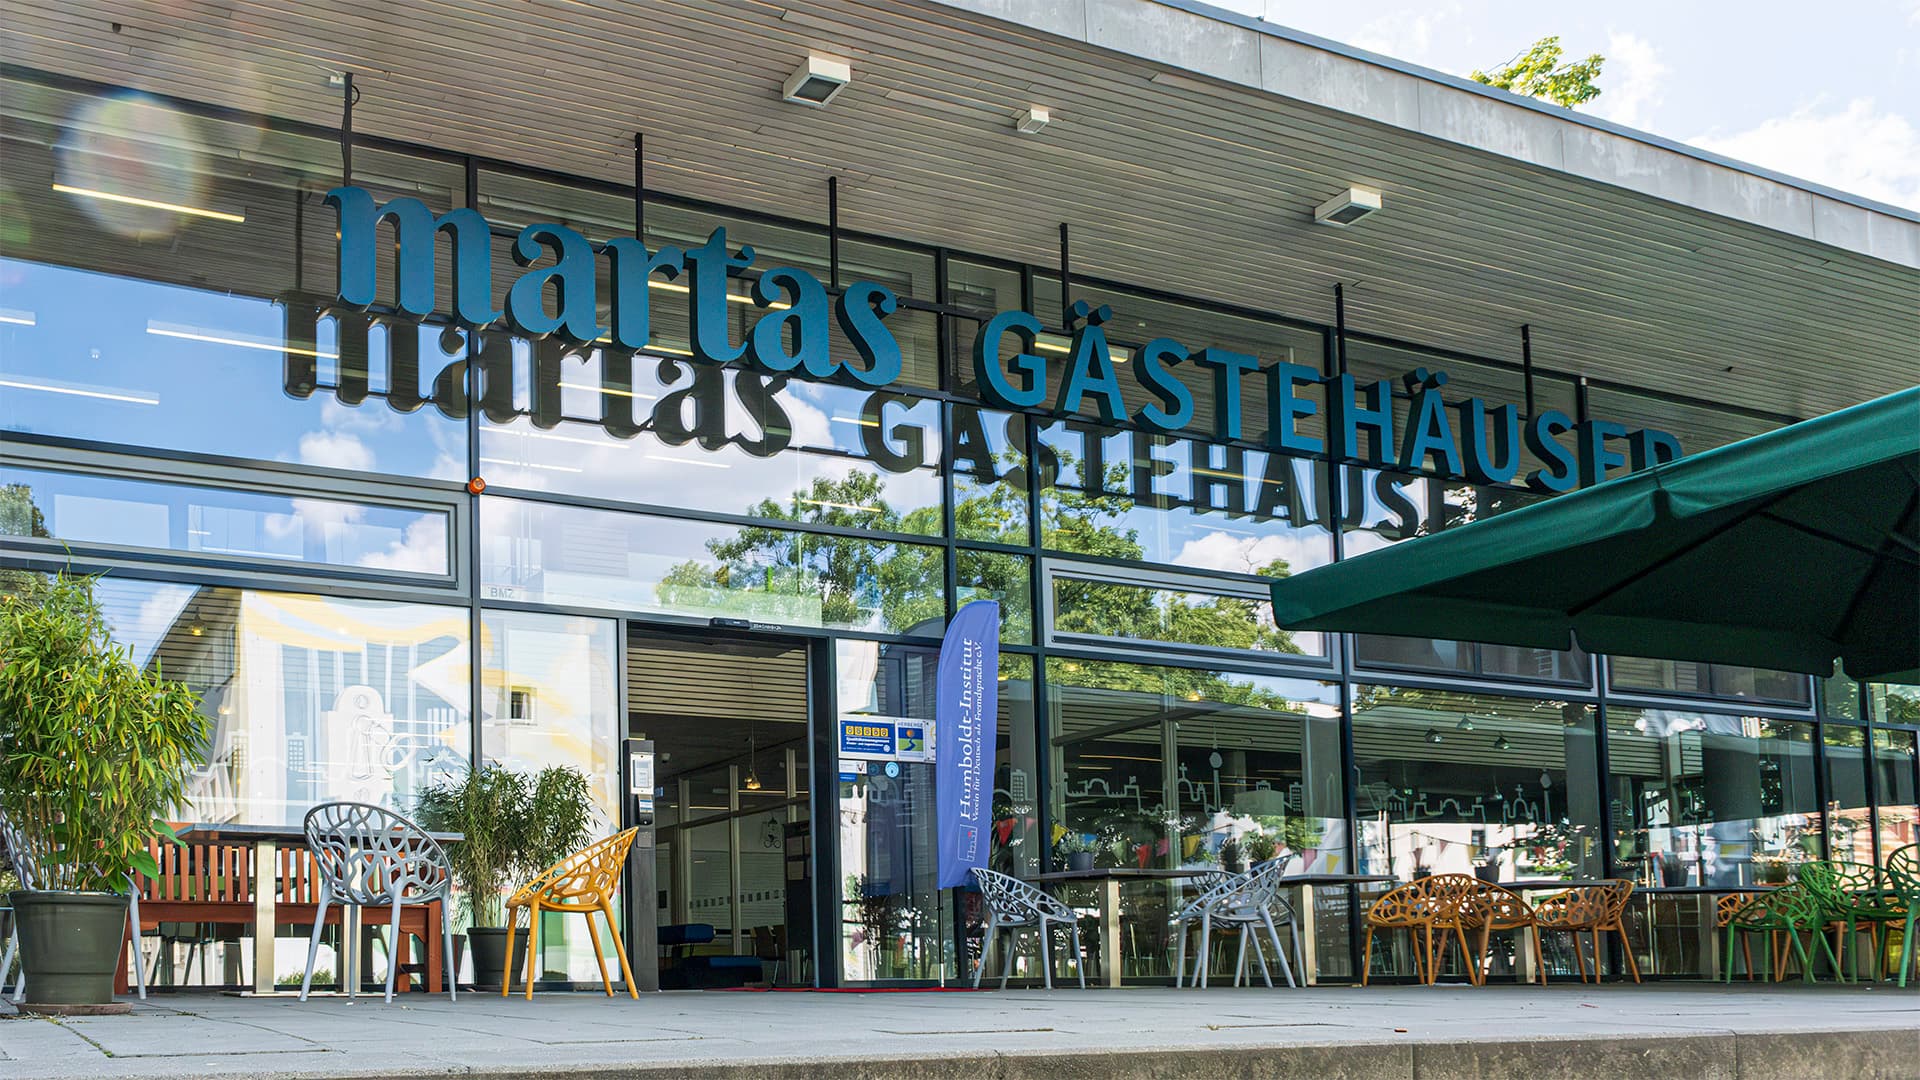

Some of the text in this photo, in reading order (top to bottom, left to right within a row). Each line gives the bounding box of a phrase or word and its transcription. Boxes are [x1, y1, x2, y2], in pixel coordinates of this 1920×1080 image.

[324, 186, 902, 387] martas
[974, 659, 984, 720] Fremdsprache
[959, 638, 973, 820] Humboldt-Institut
[973, 737, 982, 775] Deutsch
[972, 777, 981, 792] für
[972, 794, 980, 821] Verein
